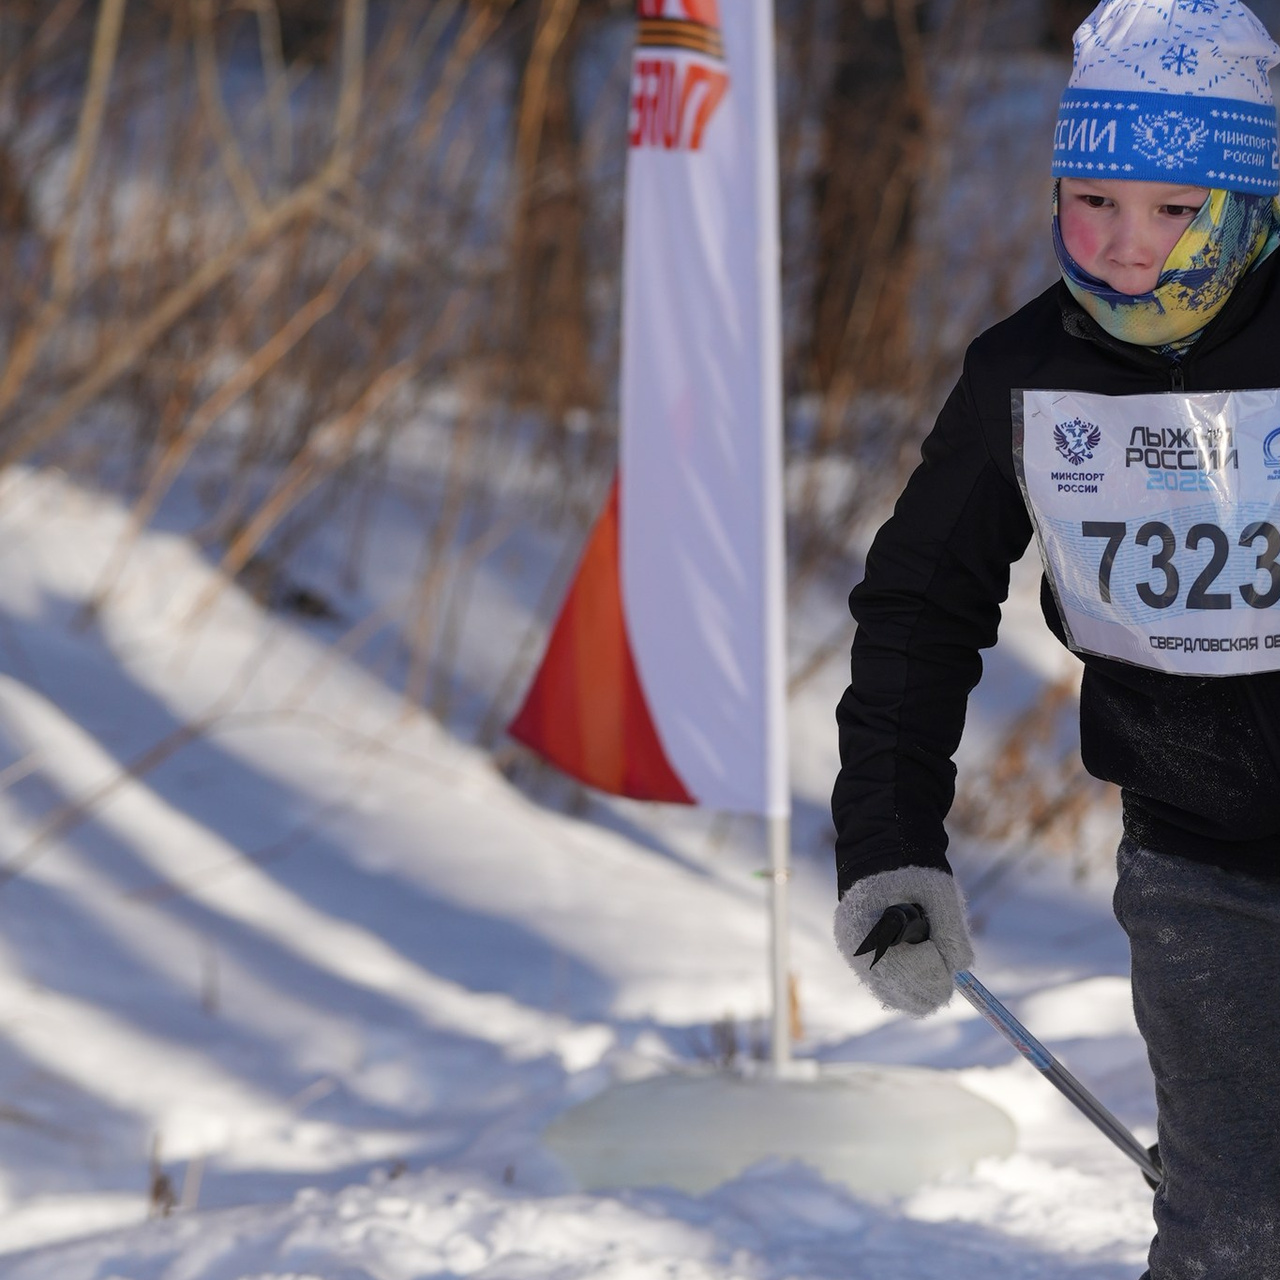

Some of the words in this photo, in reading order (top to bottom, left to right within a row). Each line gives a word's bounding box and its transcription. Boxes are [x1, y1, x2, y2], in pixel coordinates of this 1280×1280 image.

[1214, 129, 1270, 151] МИНСПОРТ
[1223, 149, 1265, 167] РОССИИ
[1125, 447, 1239, 470] РОССИИ
[1051, 472, 1105, 481] МИНСПОРТ
[1057, 483, 1098, 493] РОССИИ
[1149, 635, 1259, 653] СВЕРДЛОВСКАЯ
